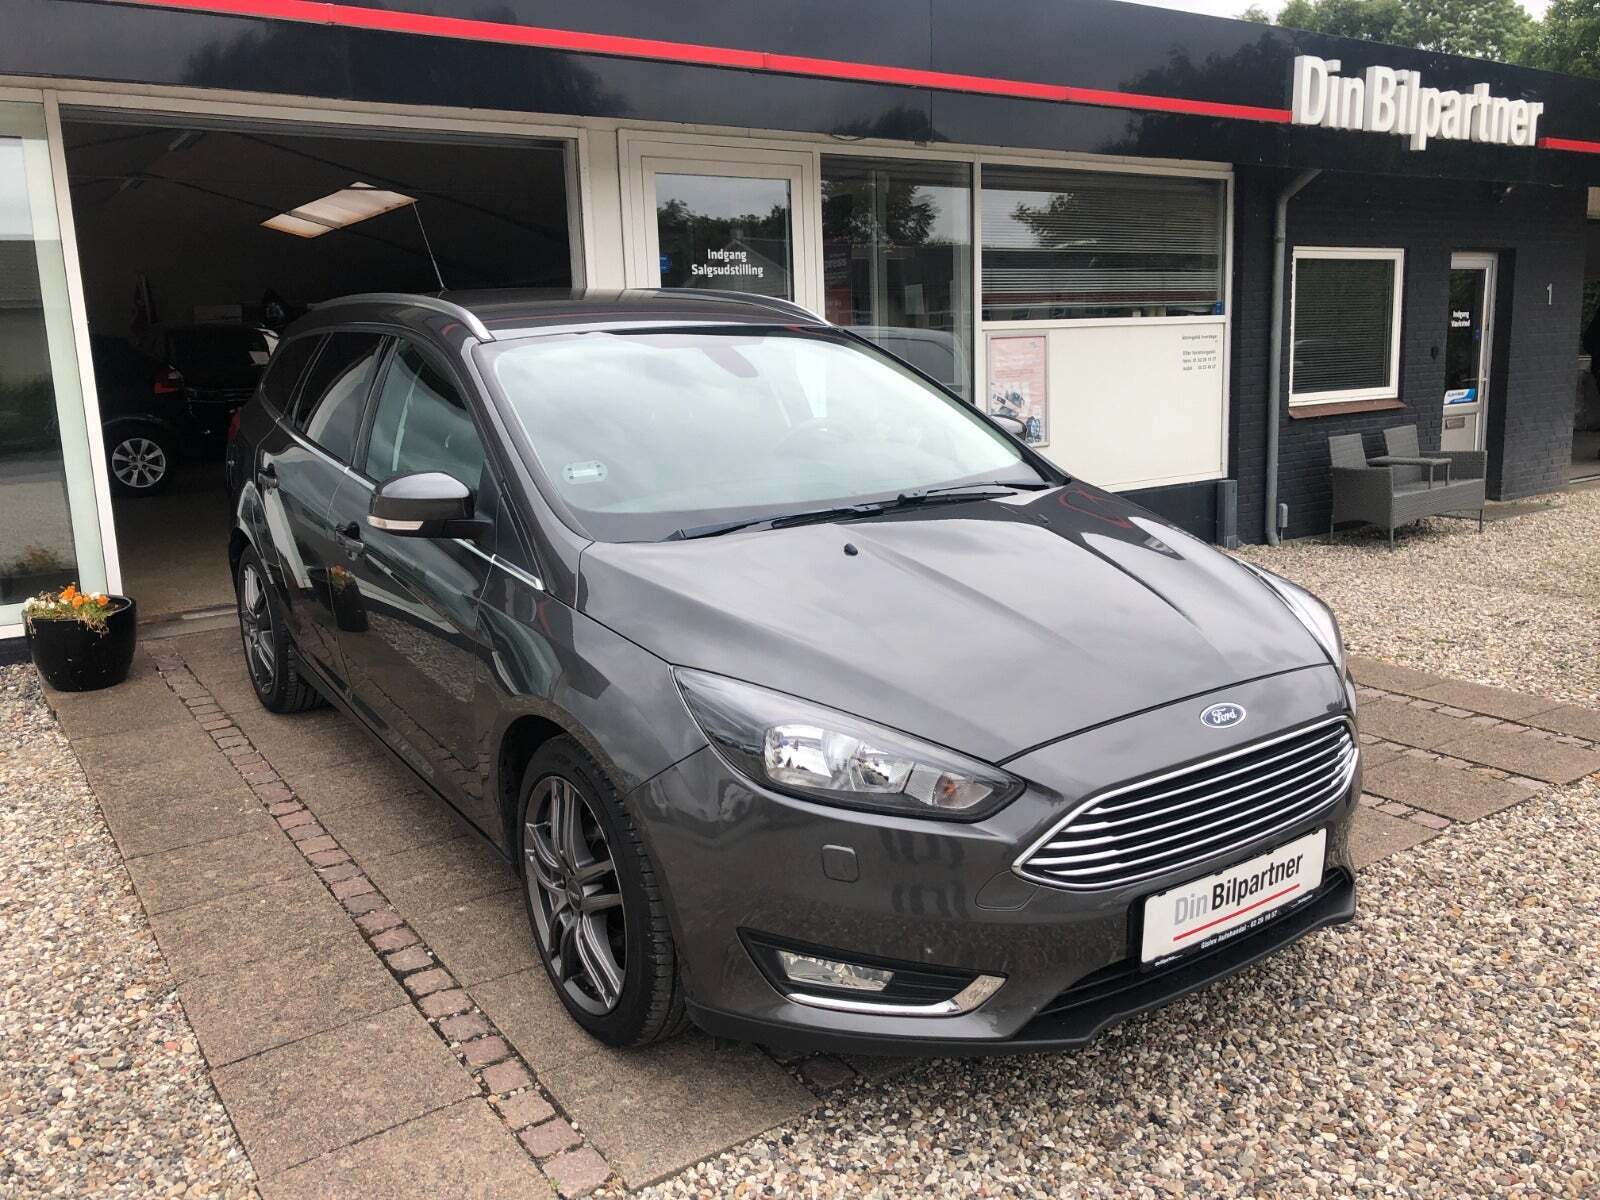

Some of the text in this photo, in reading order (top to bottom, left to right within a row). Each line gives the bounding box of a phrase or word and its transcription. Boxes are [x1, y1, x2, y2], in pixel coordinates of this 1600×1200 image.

[1292, 55, 1544, 151] Din Bilpartner
[707, 248, 747, 262] Indgang
[691, 264, 764, 278] Salgsudstilling
[1546, 283, 1553, 305] 1
[1174, 854, 1304, 926] Din Bilpartner
